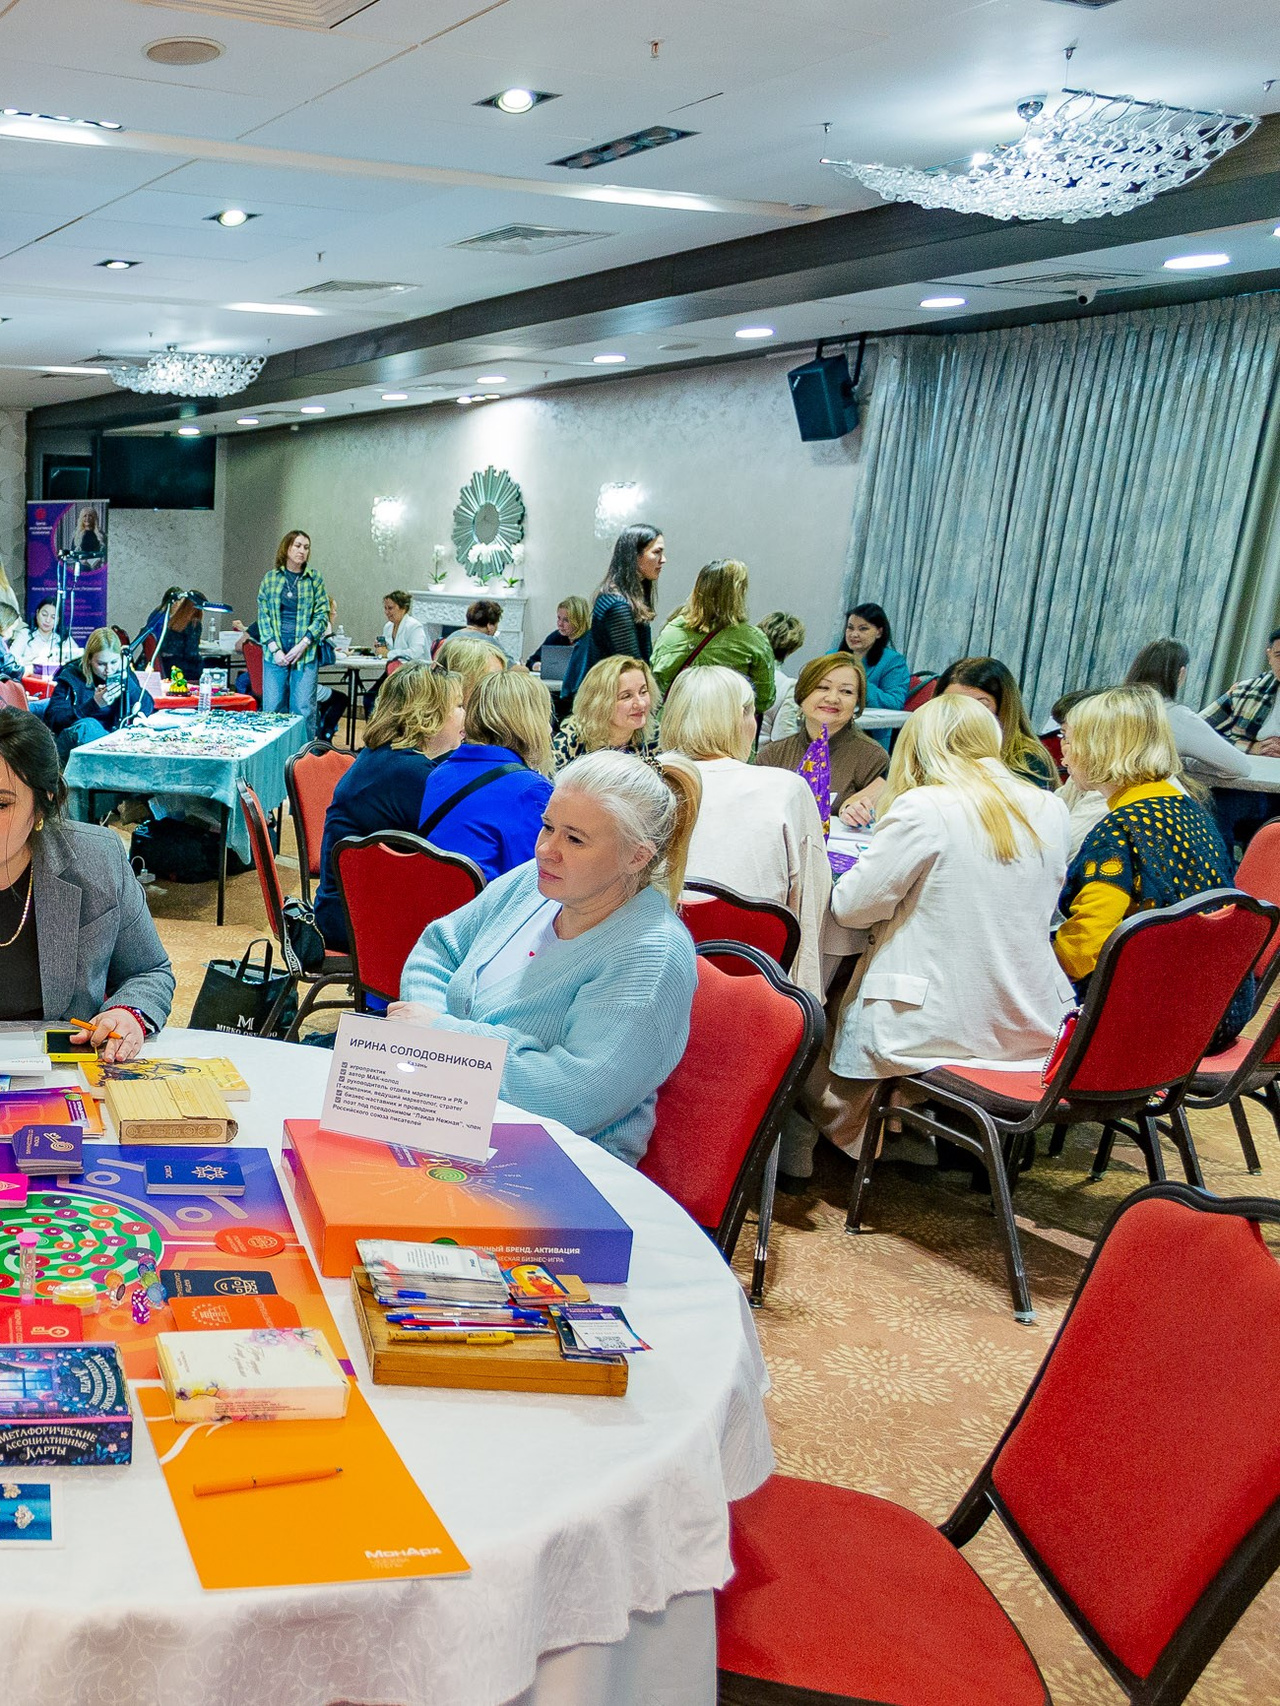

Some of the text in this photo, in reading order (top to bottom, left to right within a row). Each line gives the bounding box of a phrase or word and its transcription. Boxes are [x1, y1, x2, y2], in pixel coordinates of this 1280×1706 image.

[216, 1024, 241, 1034] MIRKO
[237, 1015, 255, 1030] M
[350, 1038, 493, 1071] ИРИНА СОЛОДОВНИКОВА
[348, 1071, 400, 1085] автор МАК-колод
[349, 1064, 386, 1075] игропрактик
[346, 1078, 388, 1090] руководитель
[389, 1086, 411, 1096] отдела
[412, 1090, 447, 1102] маркетинга
[374, 1089, 400, 1101] ведущий
[439, 1102, 463, 1112] стратег
[344, 1092, 396, 1106] бизнес-наставник
[403, 1103, 437, 1114] проводник
[369, 1103, 411, 1116] псевдонимом
[332, 1104, 422, 1126] Российского союза писателей
[71, 1367, 92, 1394] КАРТЫ
[83, 1359, 105, 1405] АССОЦИАТИВНЫЕ
[91, 1354, 117, 1411] МЕТАФОРИЧЕСКИЕ
[6, 1436, 89, 1451] АССОЦИАТИВНЫЕ
[20, 1446, 66, 1460] КАРТЫ
